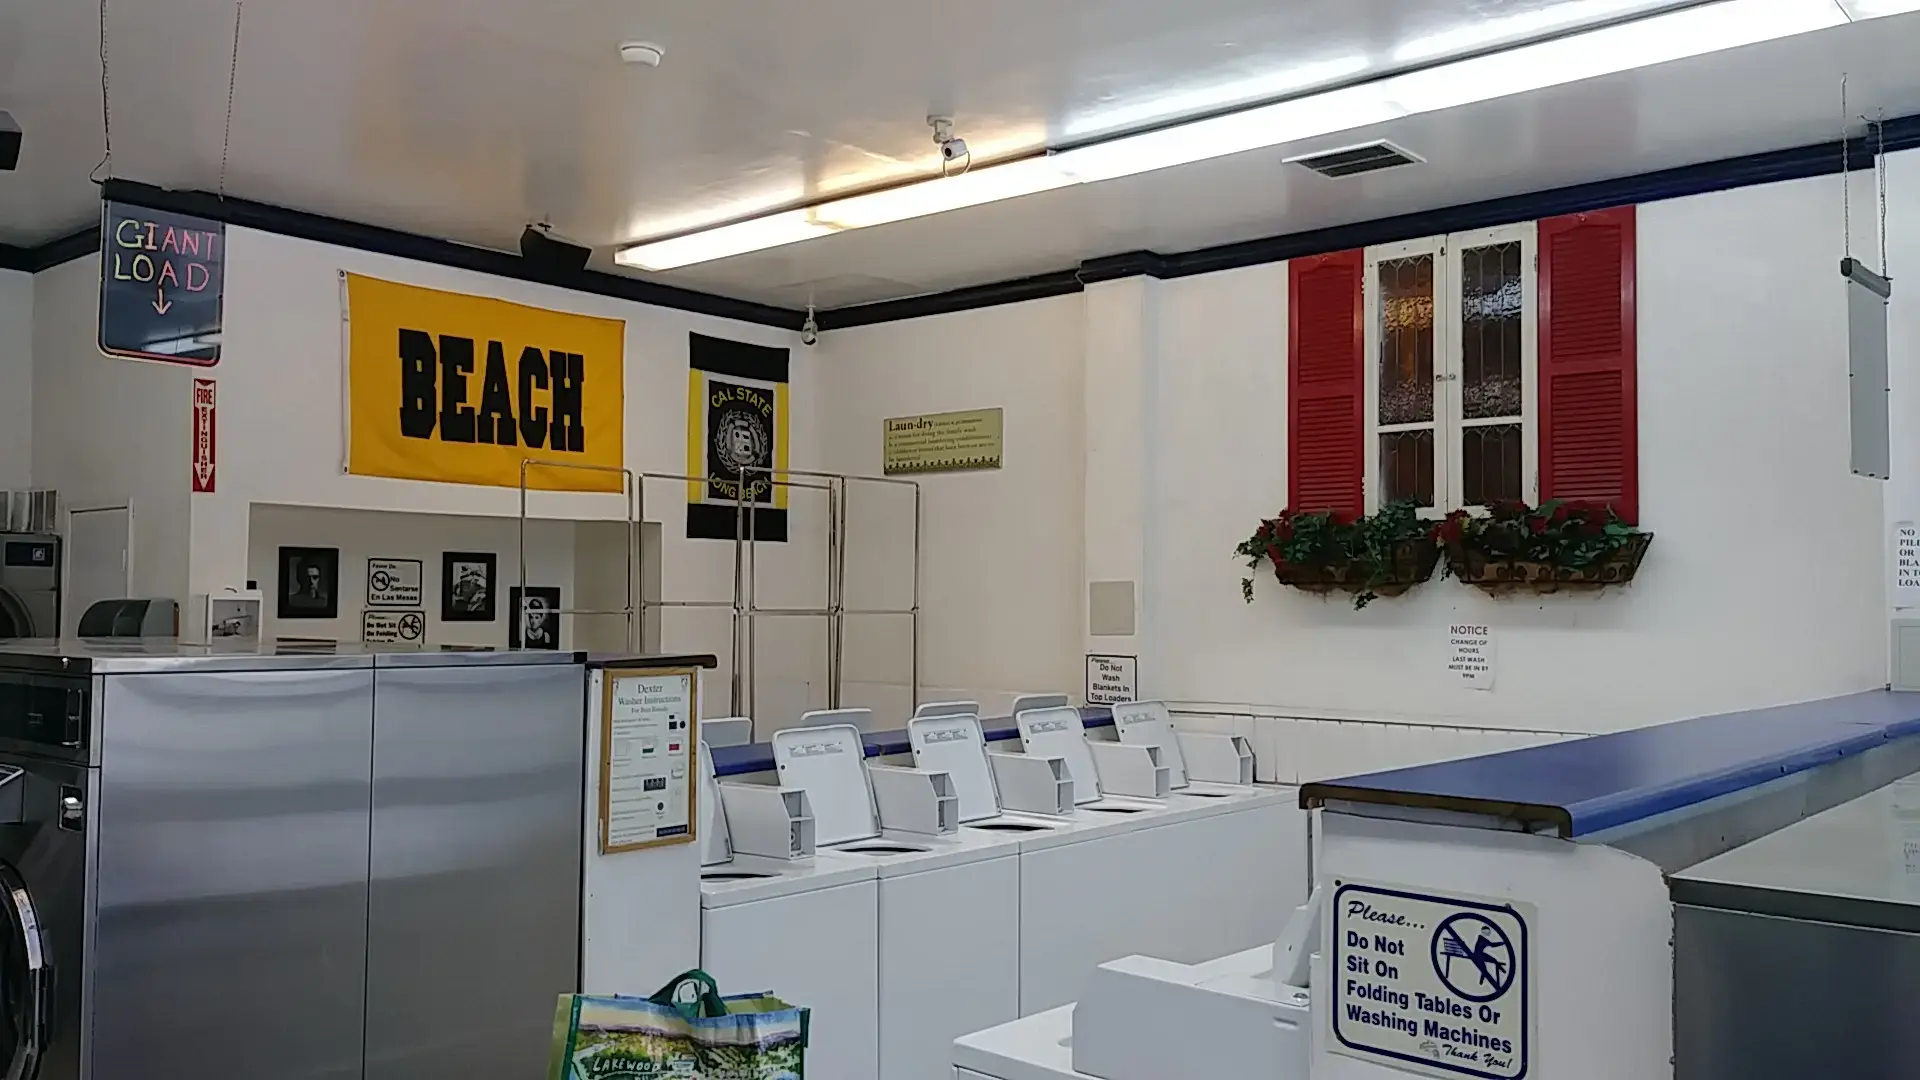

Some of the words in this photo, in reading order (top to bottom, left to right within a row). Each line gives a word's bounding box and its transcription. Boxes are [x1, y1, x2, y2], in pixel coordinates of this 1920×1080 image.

[116, 220, 217, 260] GIANT
[114, 253, 210, 292] LOAD
[197, 388, 212, 404] FIRE
[398, 328, 584, 452] BEACH
[712, 388, 734, 408] CAL
[736, 387, 772, 418] STATE
[200, 406, 208, 479] EXTINGUISHER
[709, 472, 736, 498] LONG
[1450, 625, 1488, 635] NOTICE
[638, 684, 663, 694] Dexter
[1093, 683, 1121, 692] Blankets
[1104, 693, 1132, 702] Loaders
[1348, 900, 1425, 929] Please...
[1347, 931, 1368, 950] Do
[1374, 935, 1404, 956] Not
[1347, 955, 1370, 974] Sit
[1376, 960, 1398, 979] On
[1347, 980, 1409, 1010] Folding
[1415, 992, 1472, 1019] Tables
[1478, 1005, 1500, 1025] Or
[1346, 1004, 1418, 1037] Washing
[1424, 1019, 1512, 1054] Machines
[593, 1056, 660, 1072] LAKEWOOD
[1442, 1044, 1478, 1062] Thank
[1483, 1053, 1513, 1069] You!
